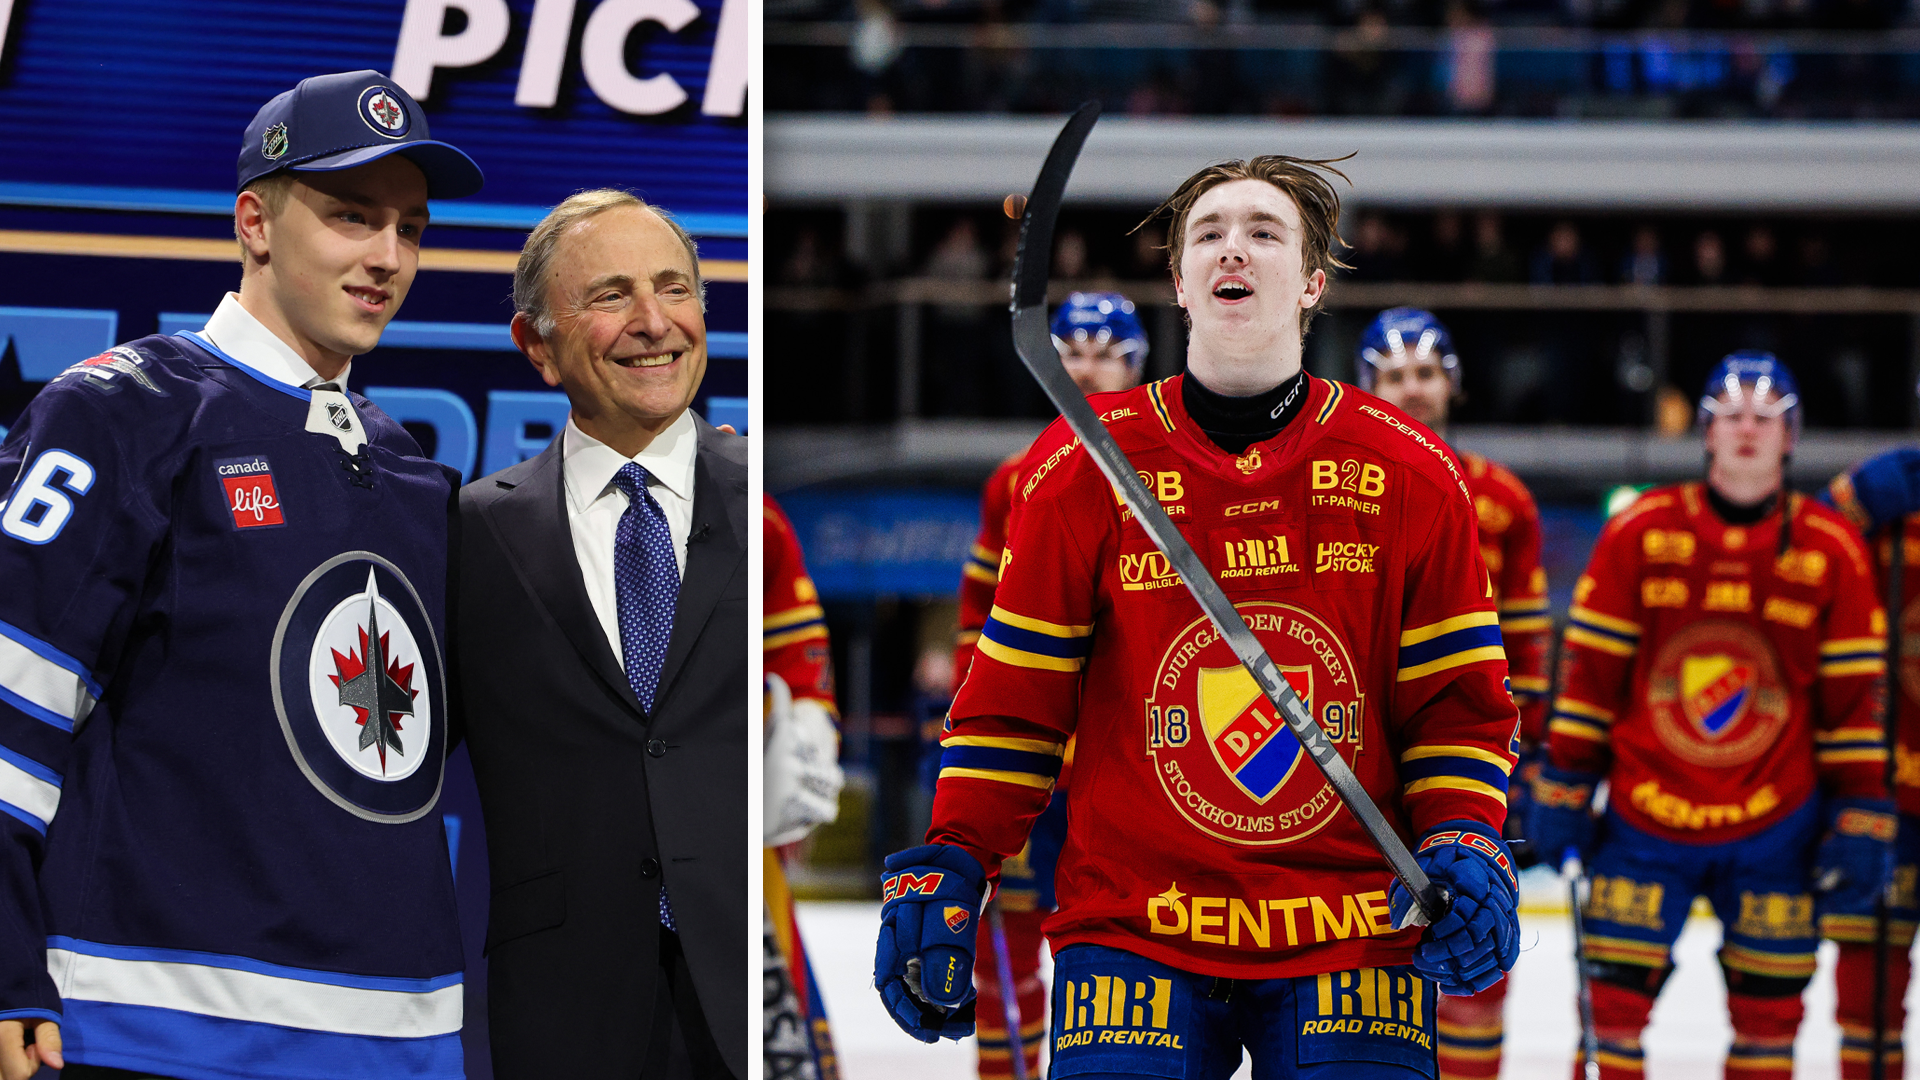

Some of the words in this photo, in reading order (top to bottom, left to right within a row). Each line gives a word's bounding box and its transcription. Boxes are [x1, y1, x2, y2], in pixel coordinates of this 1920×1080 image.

[1022, 411, 1110, 502] RIDDERMK
[1110, 407, 1139, 422] BIL
[1358, 404, 1462, 481] RIDDERMARK
[218, 458, 270, 475] canada
[1312, 459, 1386, 498] B2B
[0, 447, 97, 545] 6
[231, 486, 280, 522] life
[1224, 500, 1280, 517] CCM
[1119, 551, 1180, 583] RYD
[1220, 568, 1253, 579] ROAD
[1255, 563, 1300, 576] RENTAL
[1315, 541, 1380, 570] HOCKEY
[1332, 557, 1375, 574] STORE
[1144, 577, 1186, 591] BILGLA
[1163, 613, 1284, 691] DJURGDEN
[1287, 619, 1348, 686] HOCKEY
[1151, 705, 1191, 748] 18
[1253, 651, 1339, 766] CCM
[1322, 701, 1360, 744] 91
[1164, 759, 1275, 832] STOCKHOLMS
[883, 872, 945, 905] CM
[944, 956, 957, 993] CCM
[1056, 1030, 1094, 1053] ROAD
[1098, 1030, 1184, 1050] RENTAL
[1302, 1019, 1364, 1036] ROAD
[1368, 1020, 1432, 1051] RENTAL
